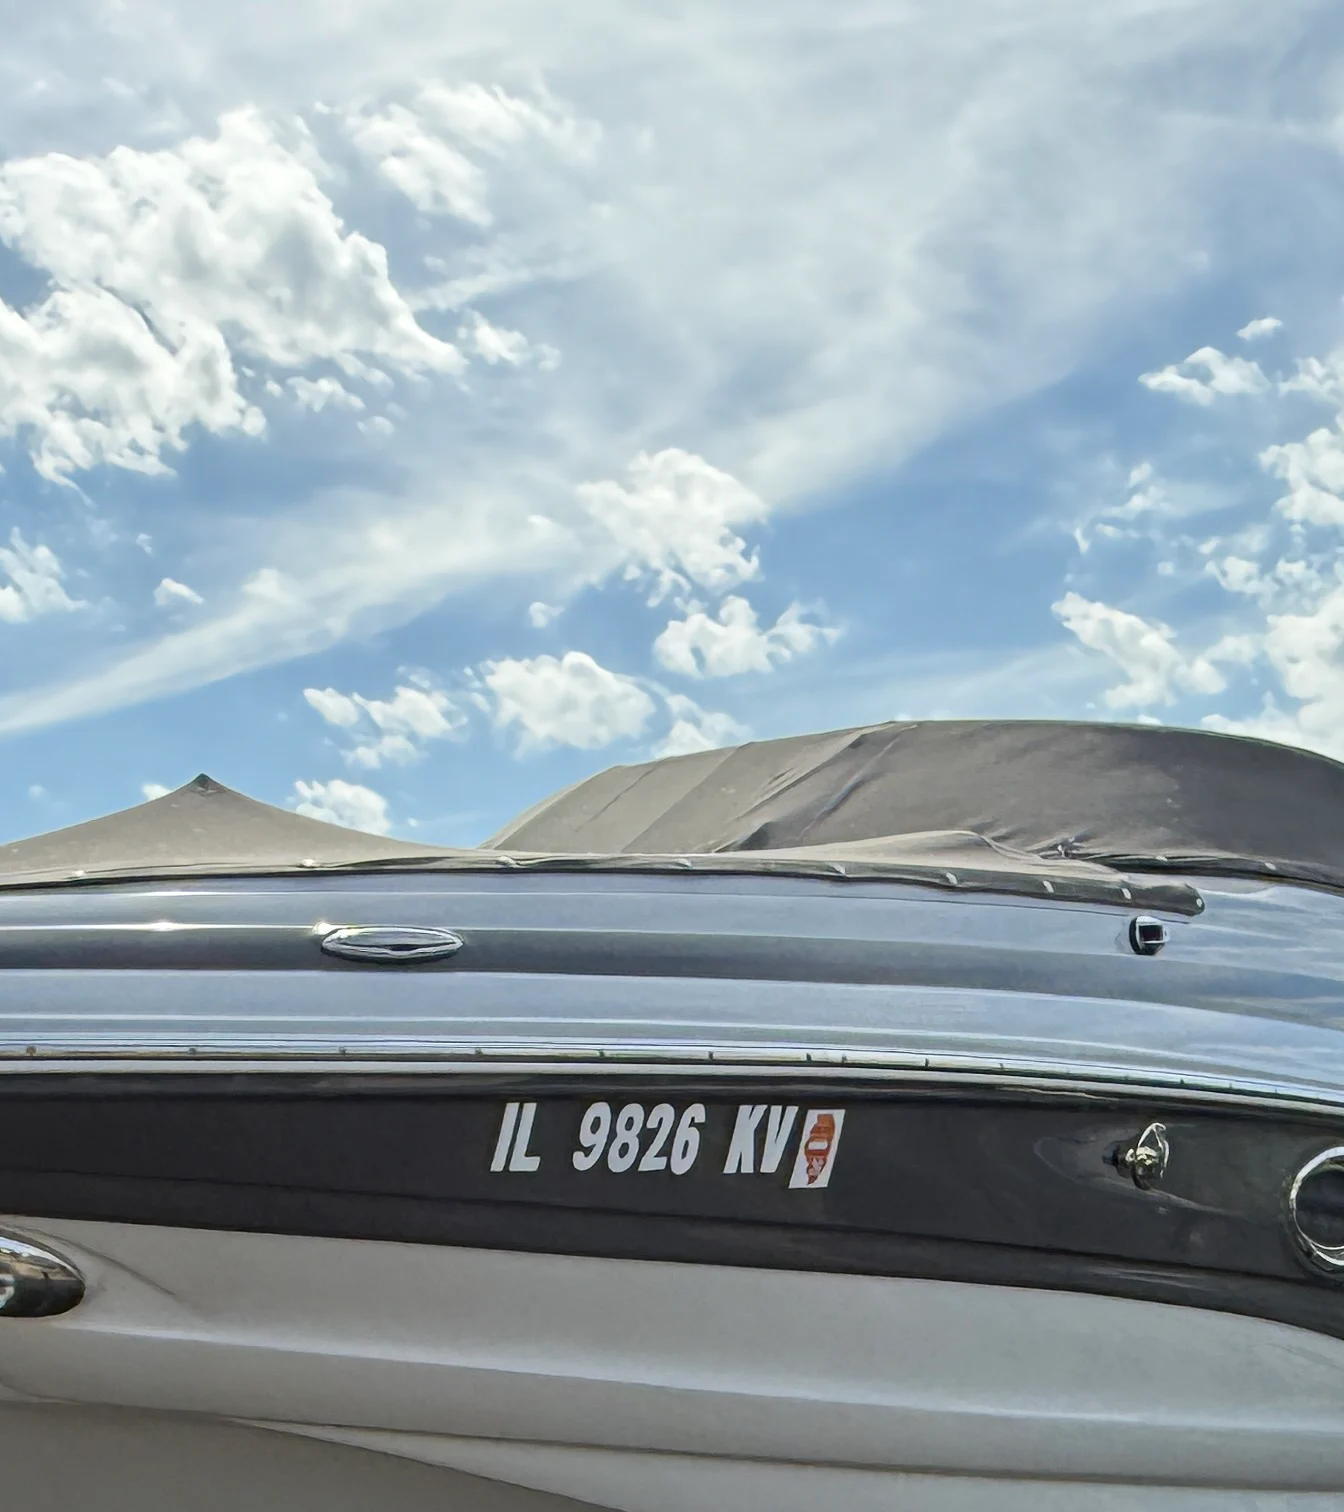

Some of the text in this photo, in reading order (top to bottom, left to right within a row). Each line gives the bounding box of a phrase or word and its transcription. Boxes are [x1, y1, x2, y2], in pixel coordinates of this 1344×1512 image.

[490, 1102, 541, 1172] IL
[572, 1102, 706, 1175] 9826
[723, 1104, 799, 1174] KV
